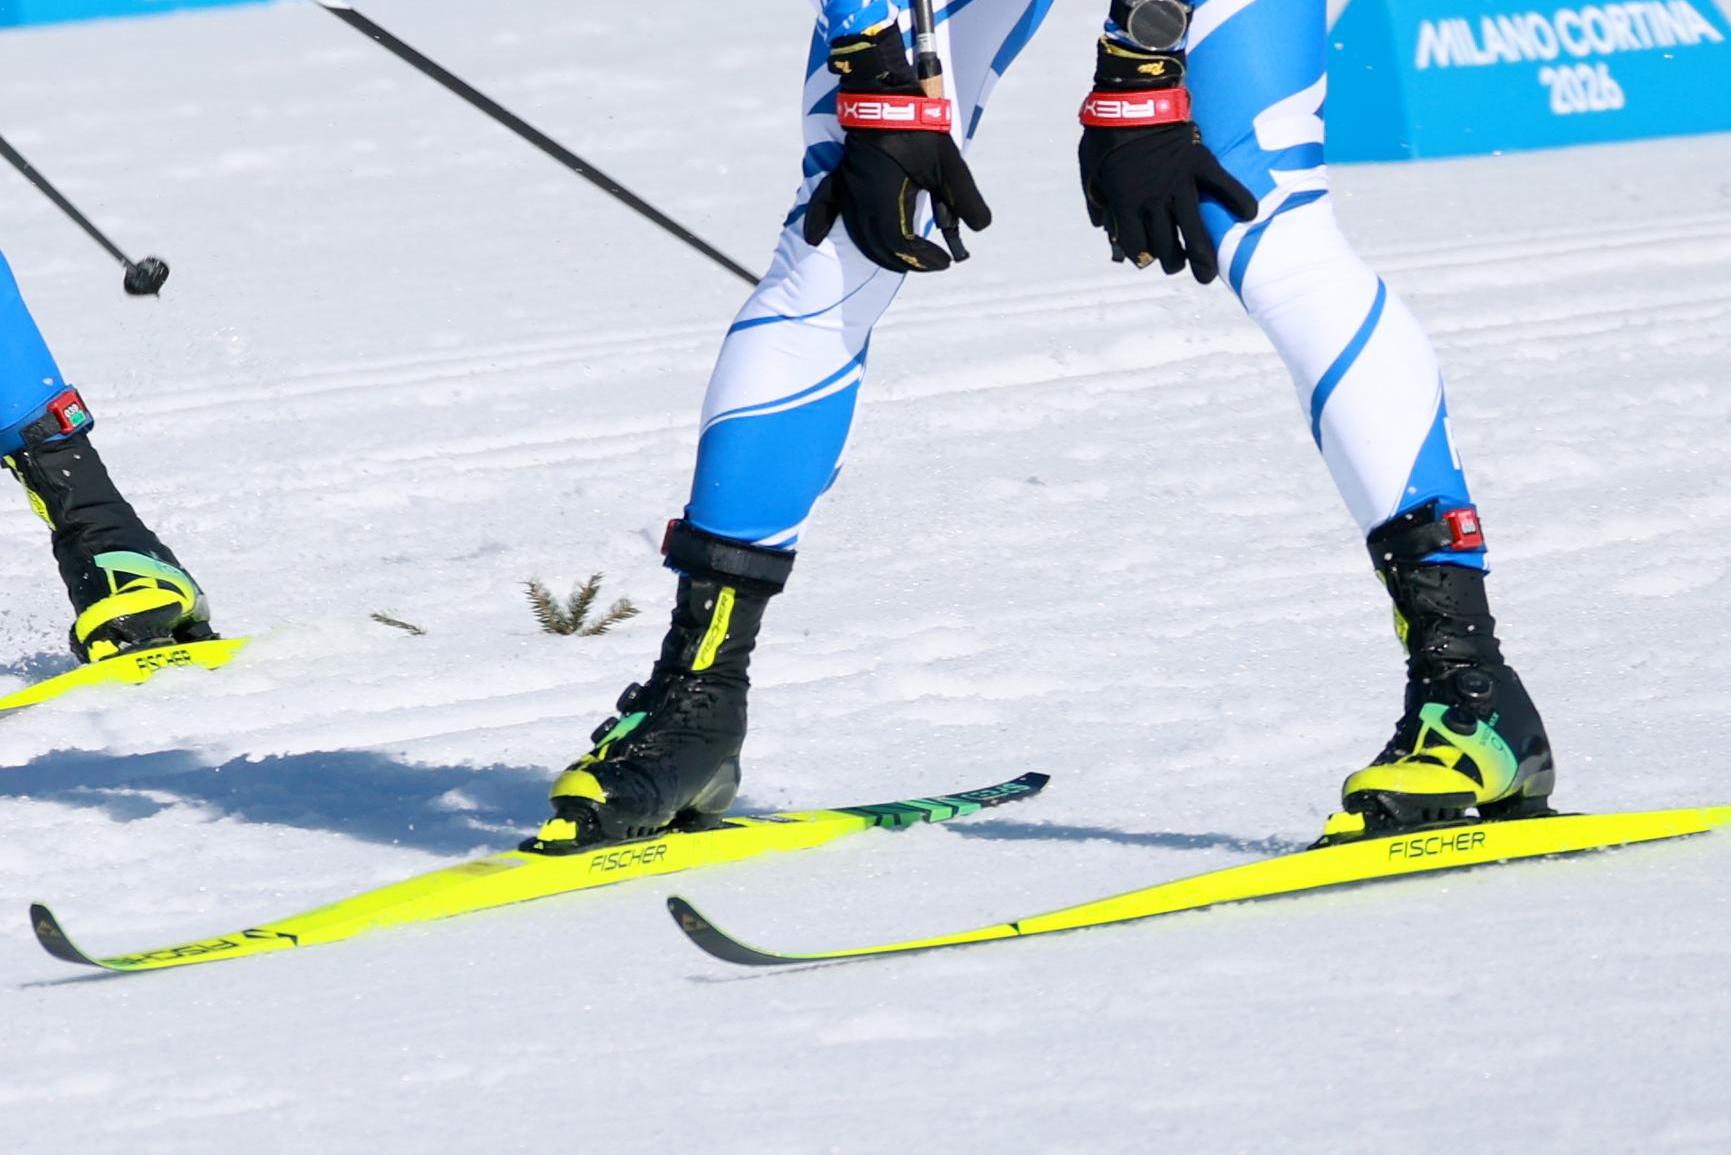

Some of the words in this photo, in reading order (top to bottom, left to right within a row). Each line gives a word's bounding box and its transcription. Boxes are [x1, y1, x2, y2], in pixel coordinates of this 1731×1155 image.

[1415, 10, 1559, 70] MILANO
[1538, 61, 1625, 114] 2026
[844, 101, 915, 120] REX
[135, 649, 192, 676] FISCHER
[588, 844, 668, 874] FISCHER
[1388, 831, 1486, 861] FISCHER
